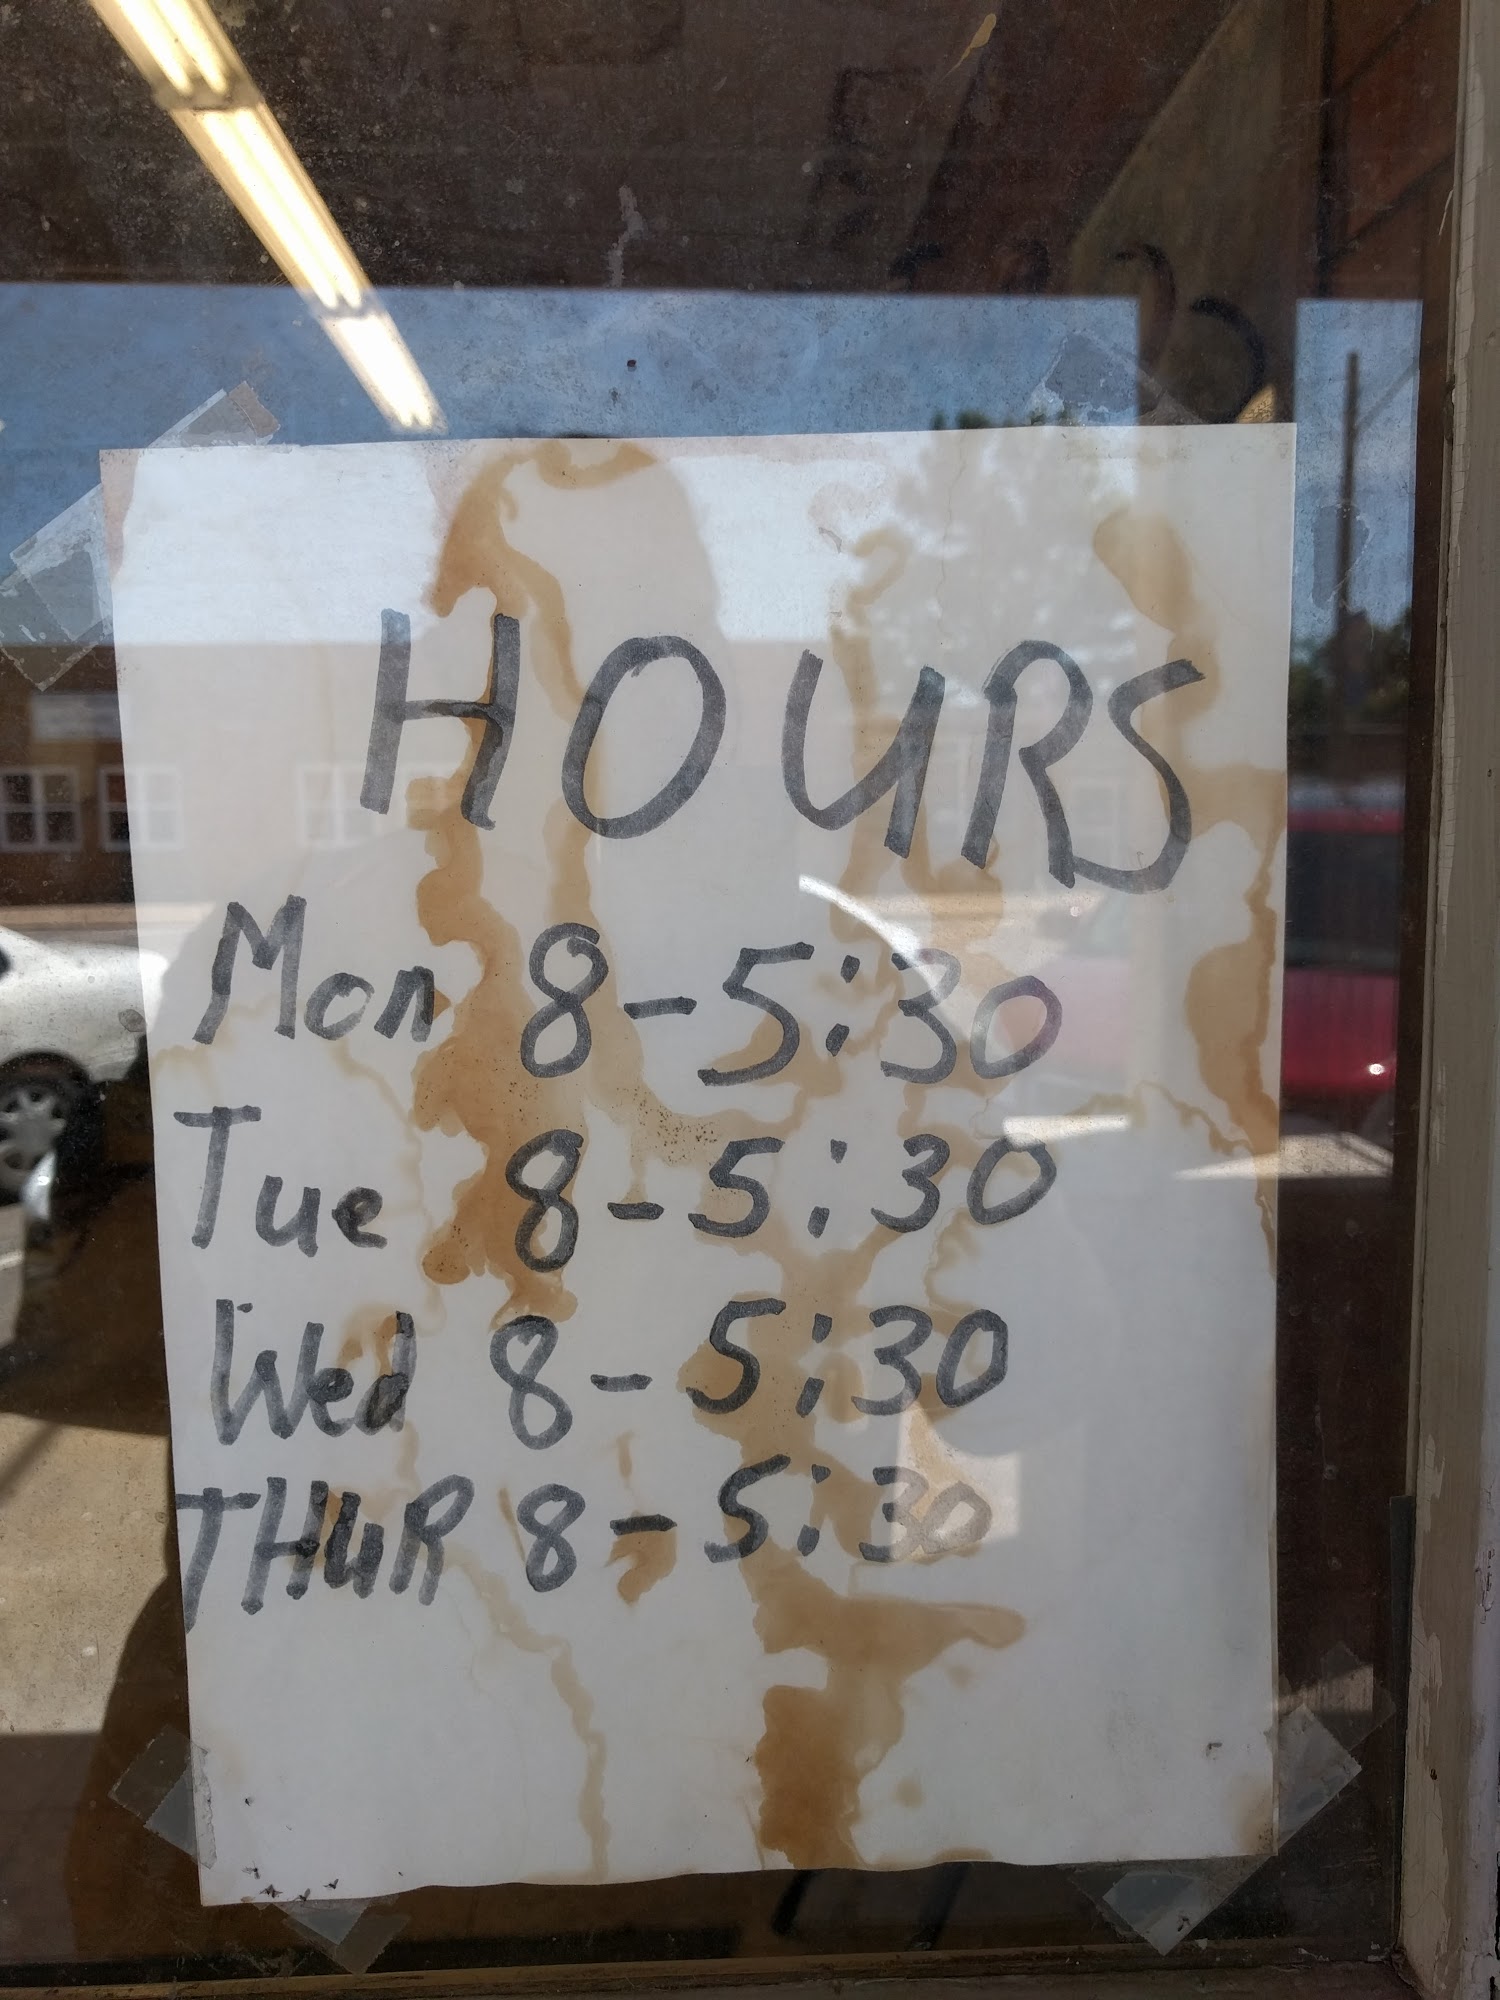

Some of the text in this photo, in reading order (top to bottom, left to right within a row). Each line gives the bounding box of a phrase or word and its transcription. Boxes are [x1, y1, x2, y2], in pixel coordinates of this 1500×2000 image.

[360, 608, 1206, 891] HOURS
[192, 895, 436, 1046] Mon
[174, 1105, 388, 1257] Tue
[210, 1298, 417, 1446] Wed
